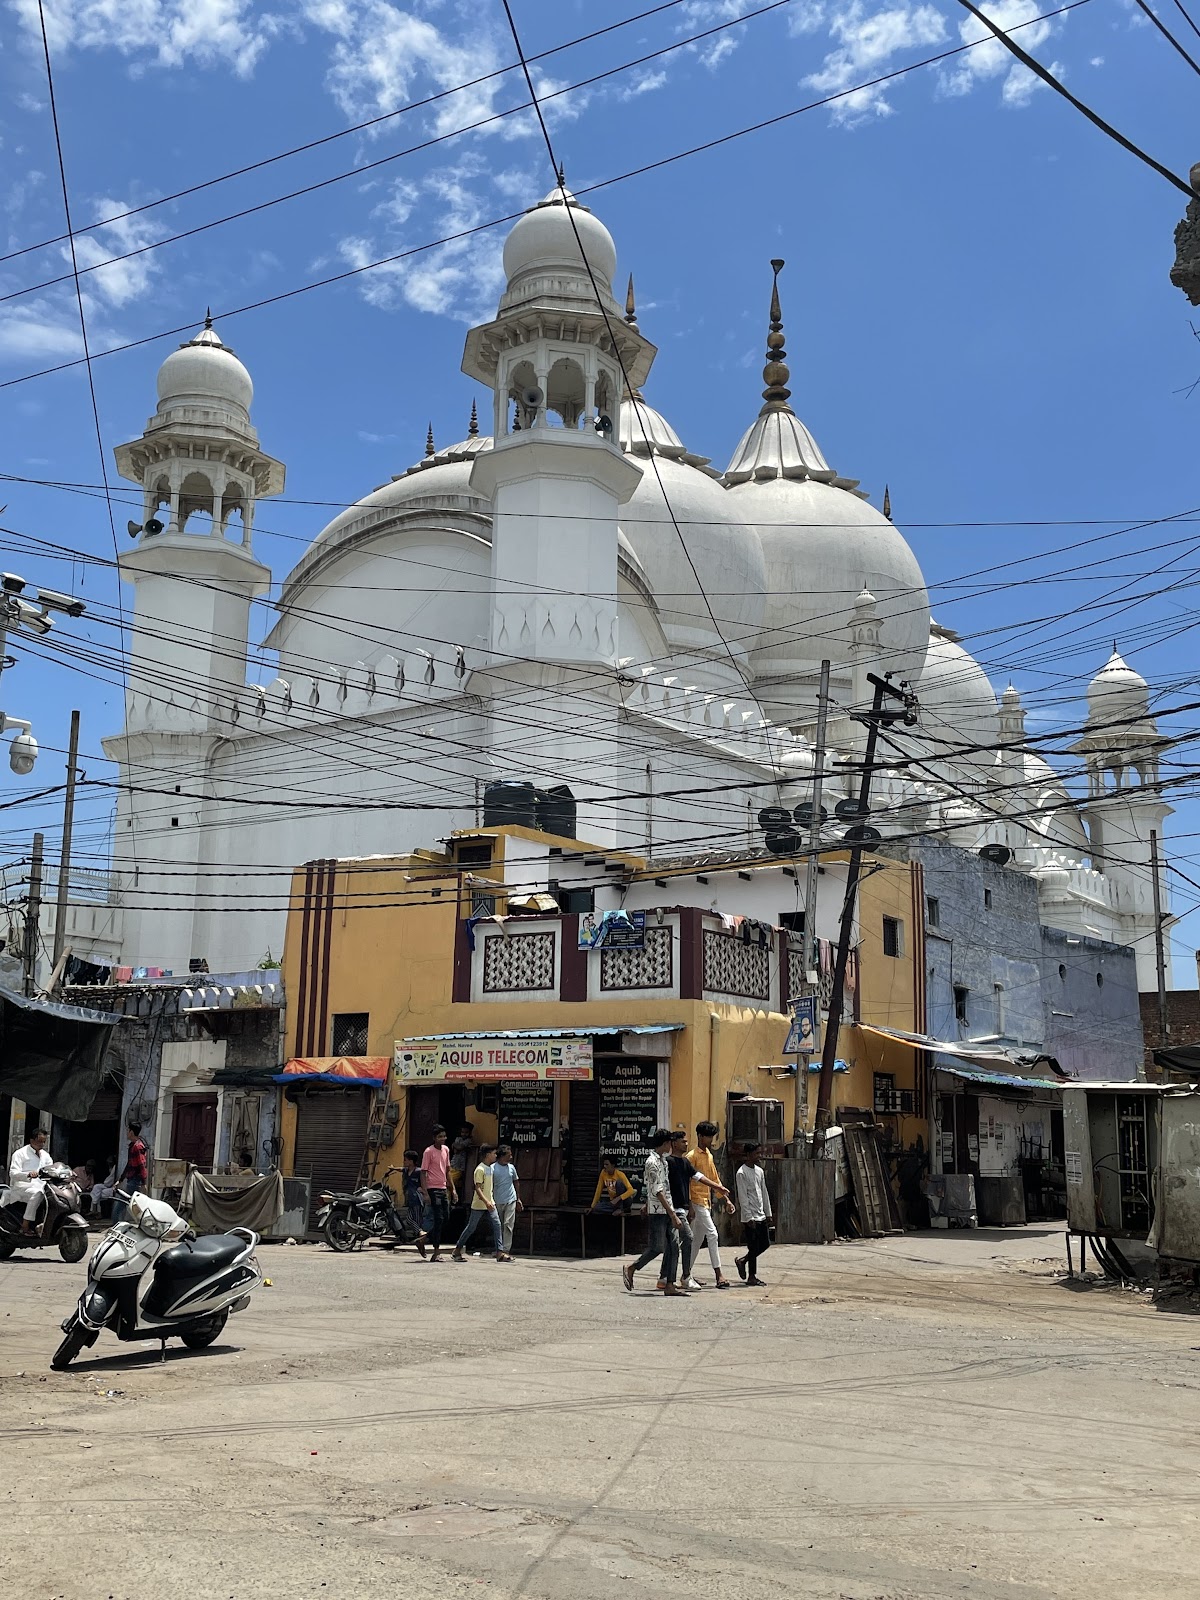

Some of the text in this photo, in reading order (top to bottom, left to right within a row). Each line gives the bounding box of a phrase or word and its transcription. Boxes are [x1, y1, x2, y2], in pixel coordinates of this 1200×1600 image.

[440, 1050, 483, 1066] AQUIB
[487, 1049, 549, 1065] TELECOM
[615, 1065, 642, 1077] Aquib
[600, 1077, 656, 1086] Communication
[511, 1131, 537, 1144] Aquib
[614, 1131, 641, 1144] Aquib
[600, 1146, 629, 1157] Security
